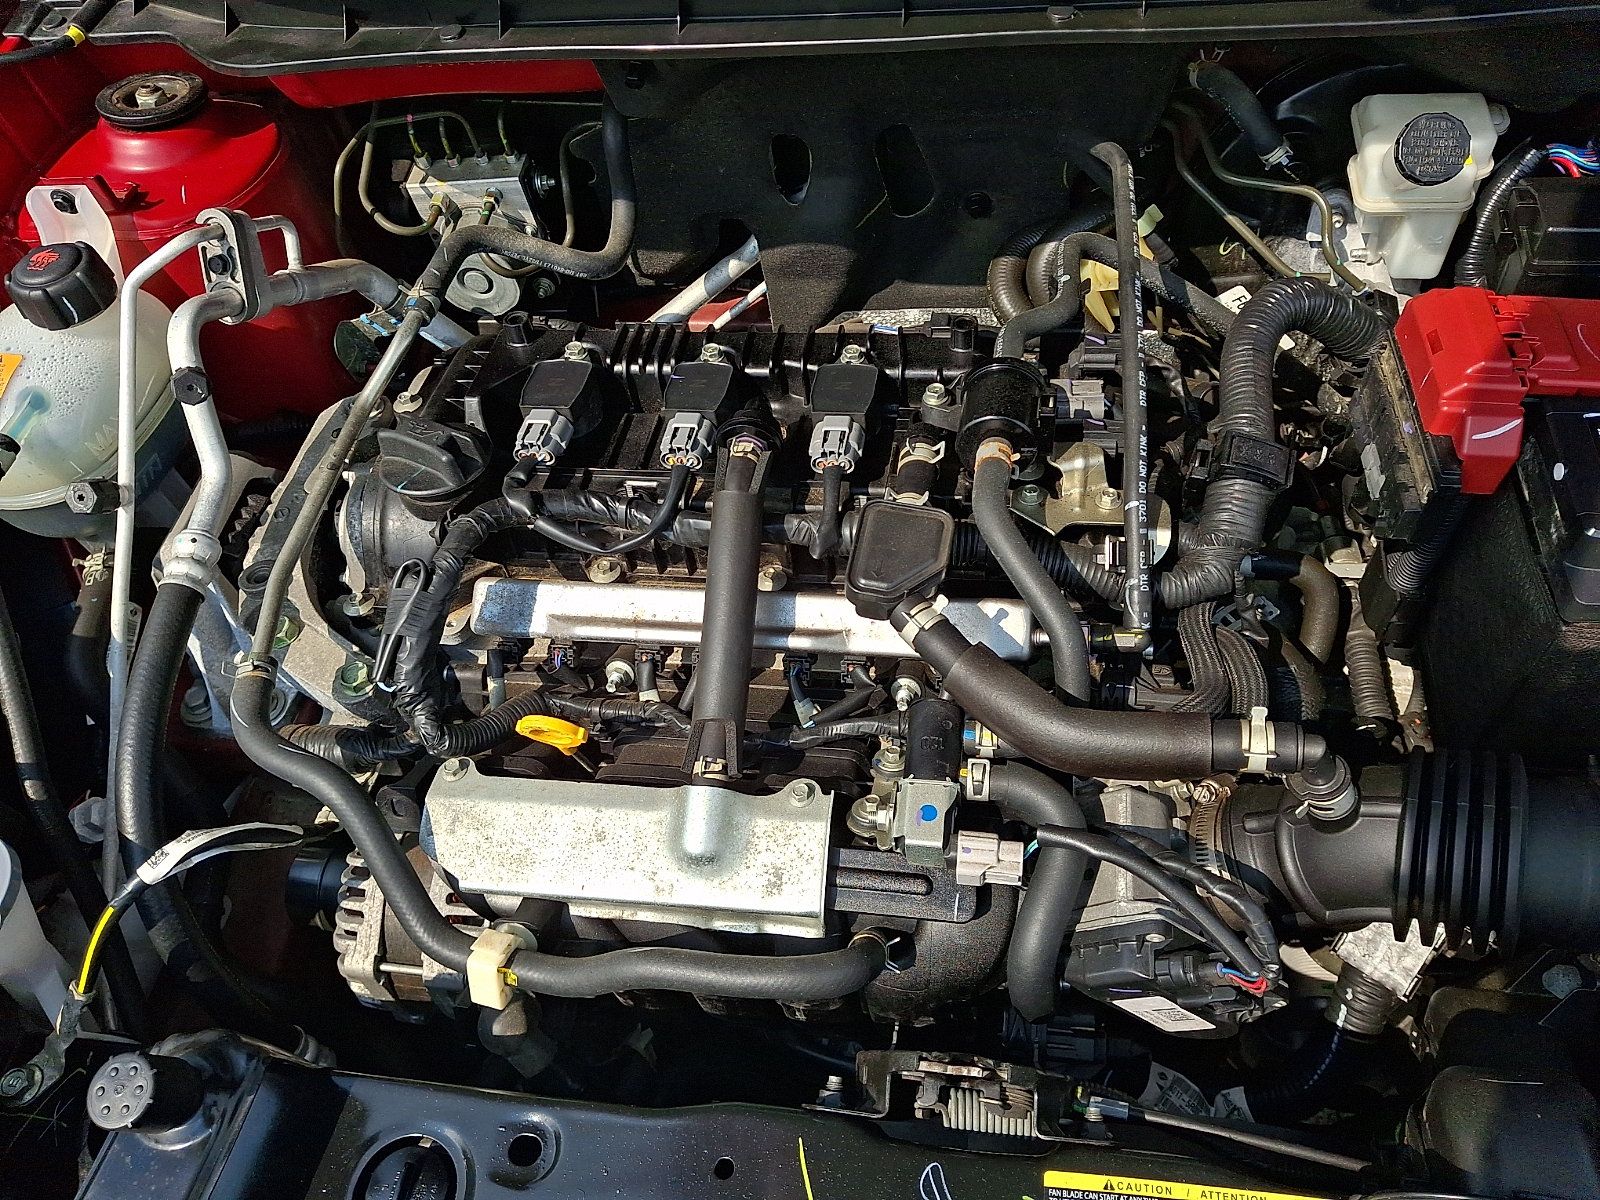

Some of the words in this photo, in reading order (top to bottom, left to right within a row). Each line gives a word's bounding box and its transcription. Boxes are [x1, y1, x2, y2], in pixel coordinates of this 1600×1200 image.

[1139, 434, 1148, 457] KINK
[1139, 459, 1148, 478] NOT
[1139, 481, 1147, 494] DO
[1139, 500, 1147, 523] 3701
[1140, 573, 1149, 592] DTR
[1048, 1188, 1061, 1197] FAN
[1062, 1190, 1083, 1199] BLADE
[1083, 1192, 1098, 1200] CAN
[1116, 1181, 1172, 1195] CAUTION
